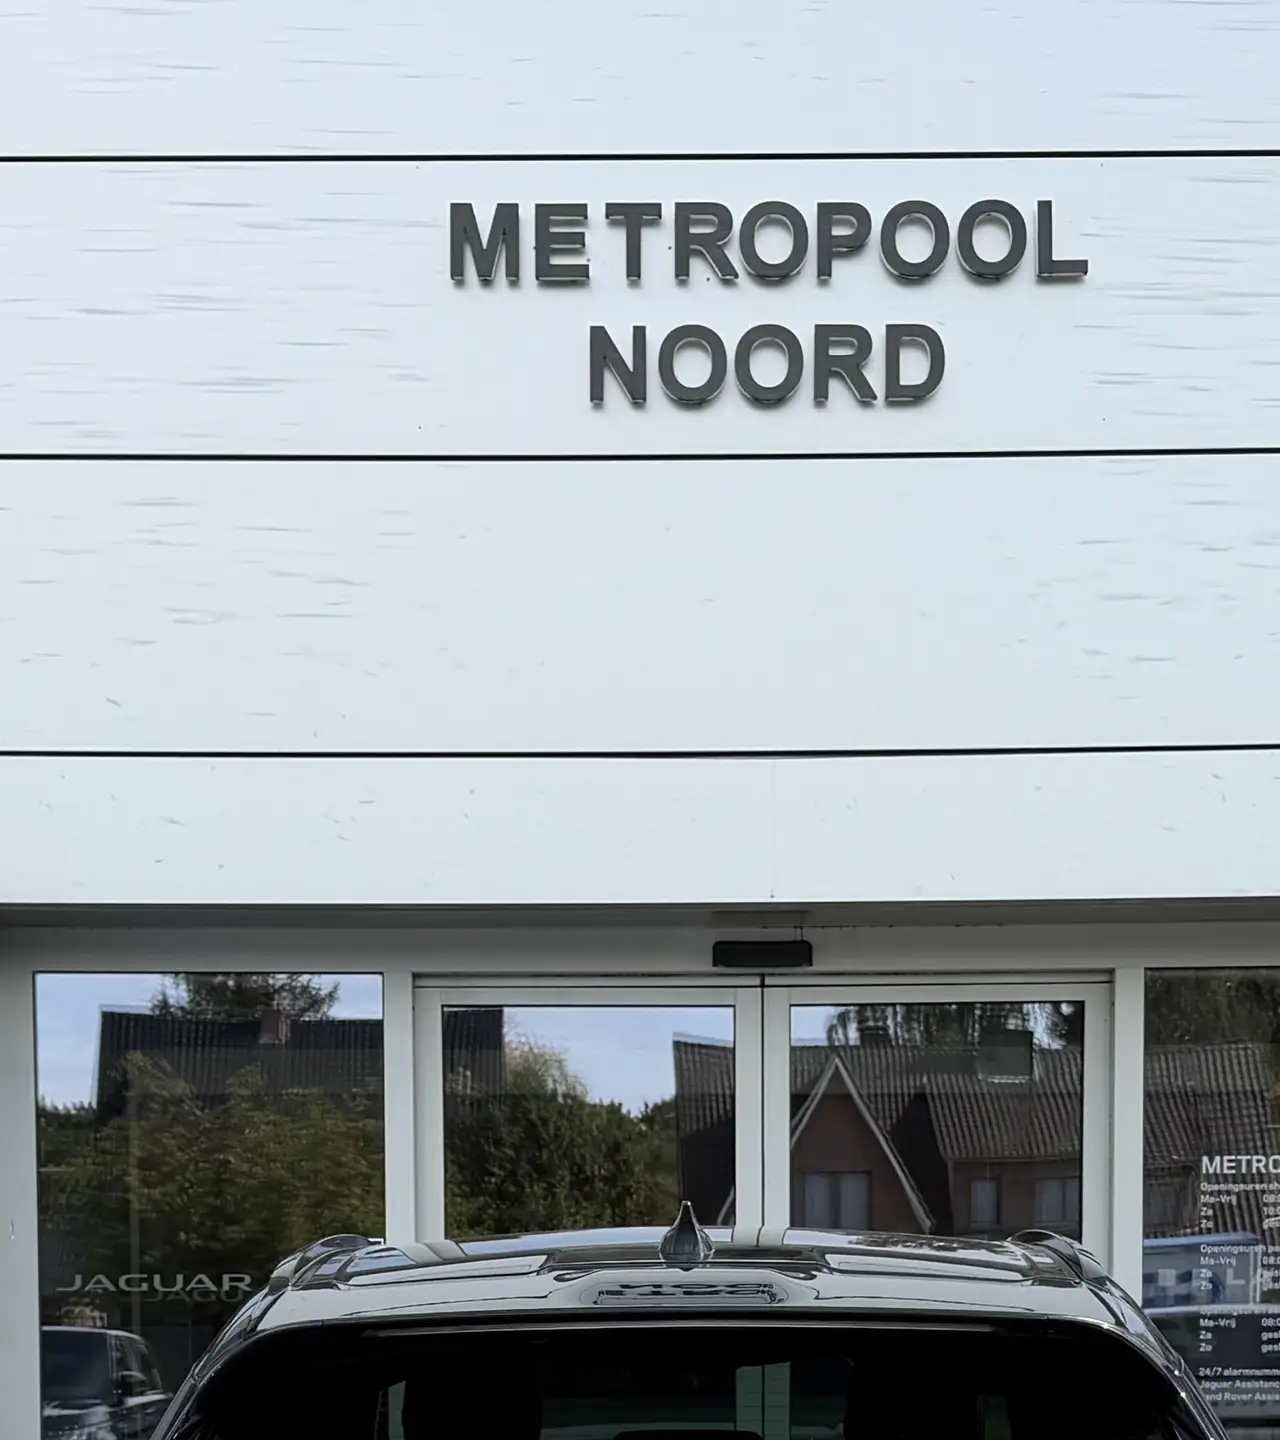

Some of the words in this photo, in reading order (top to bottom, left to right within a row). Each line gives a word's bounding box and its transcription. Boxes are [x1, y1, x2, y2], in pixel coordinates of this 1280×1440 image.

[449, 200, 1089, 281] METROPOOL
[589, 324, 946, 405] NOORD
[55, 1273, 253, 1292] JAGUAR
